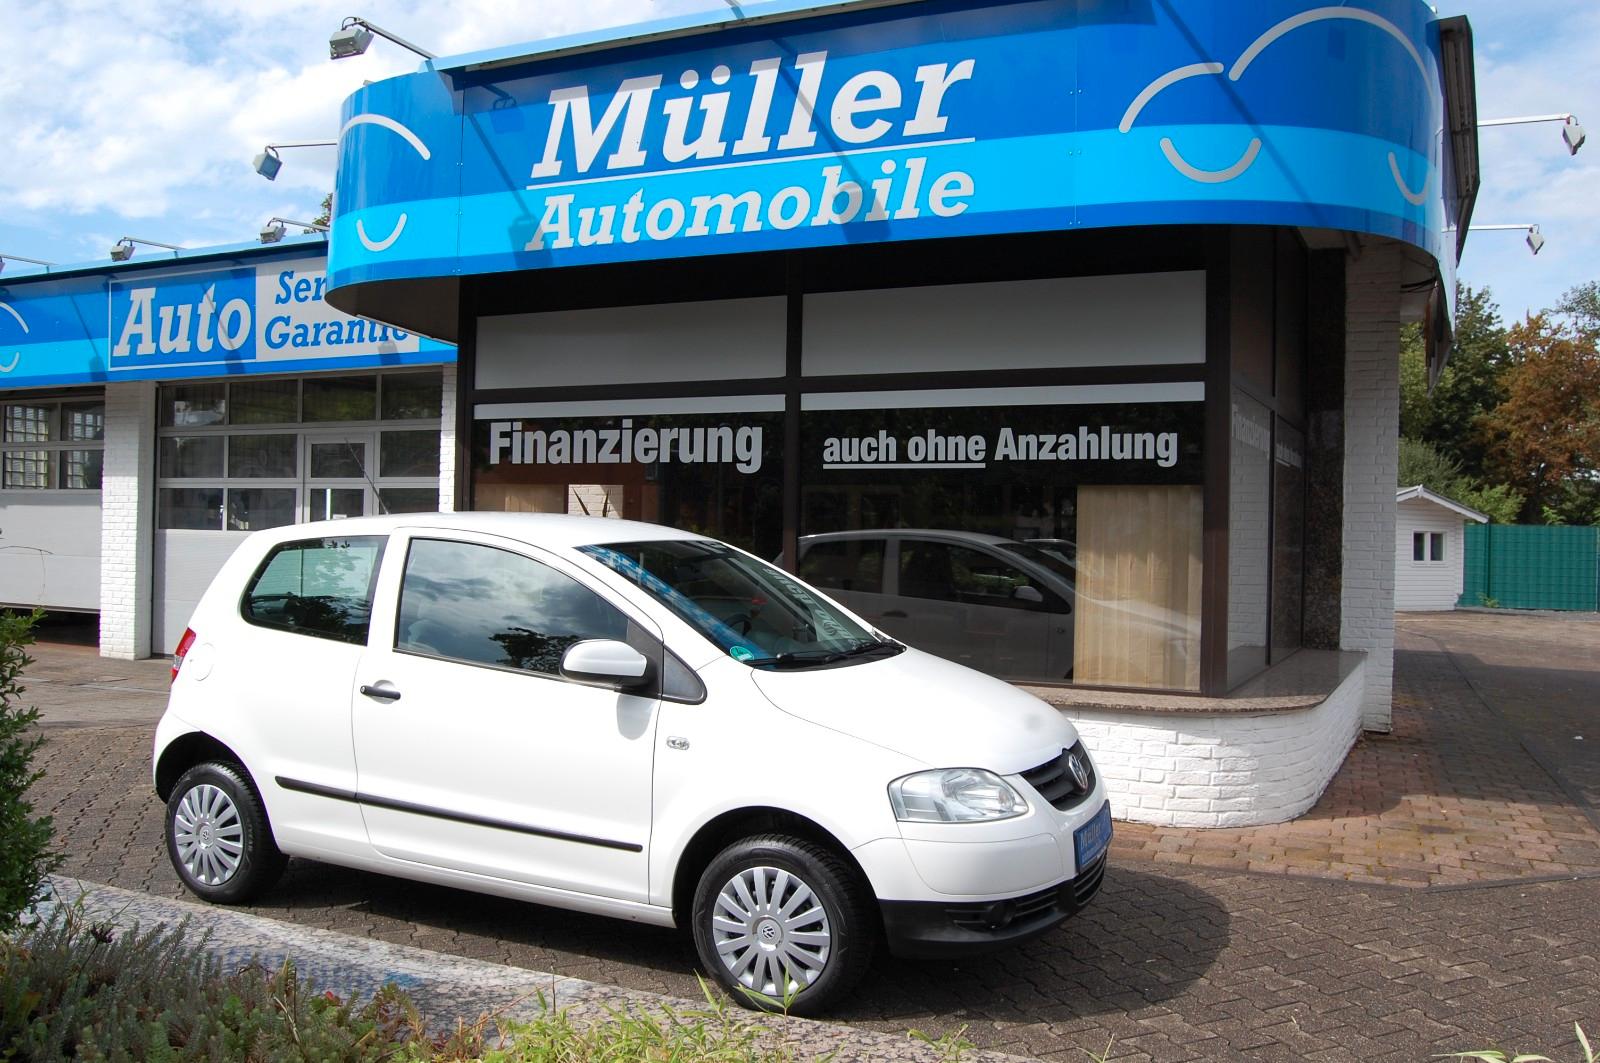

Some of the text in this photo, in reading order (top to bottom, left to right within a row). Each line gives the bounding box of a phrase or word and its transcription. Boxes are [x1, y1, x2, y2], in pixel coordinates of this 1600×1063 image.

[530, 50, 975, 178] Müller
[524, 157, 975, 252] Automobile
[275, 270, 327, 305] Ser
[112, 283, 252, 357] Auto
[490, 419, 763, 474] Finanzierung
[823, 426, 1178, 468] auch ohne Anzahlung
